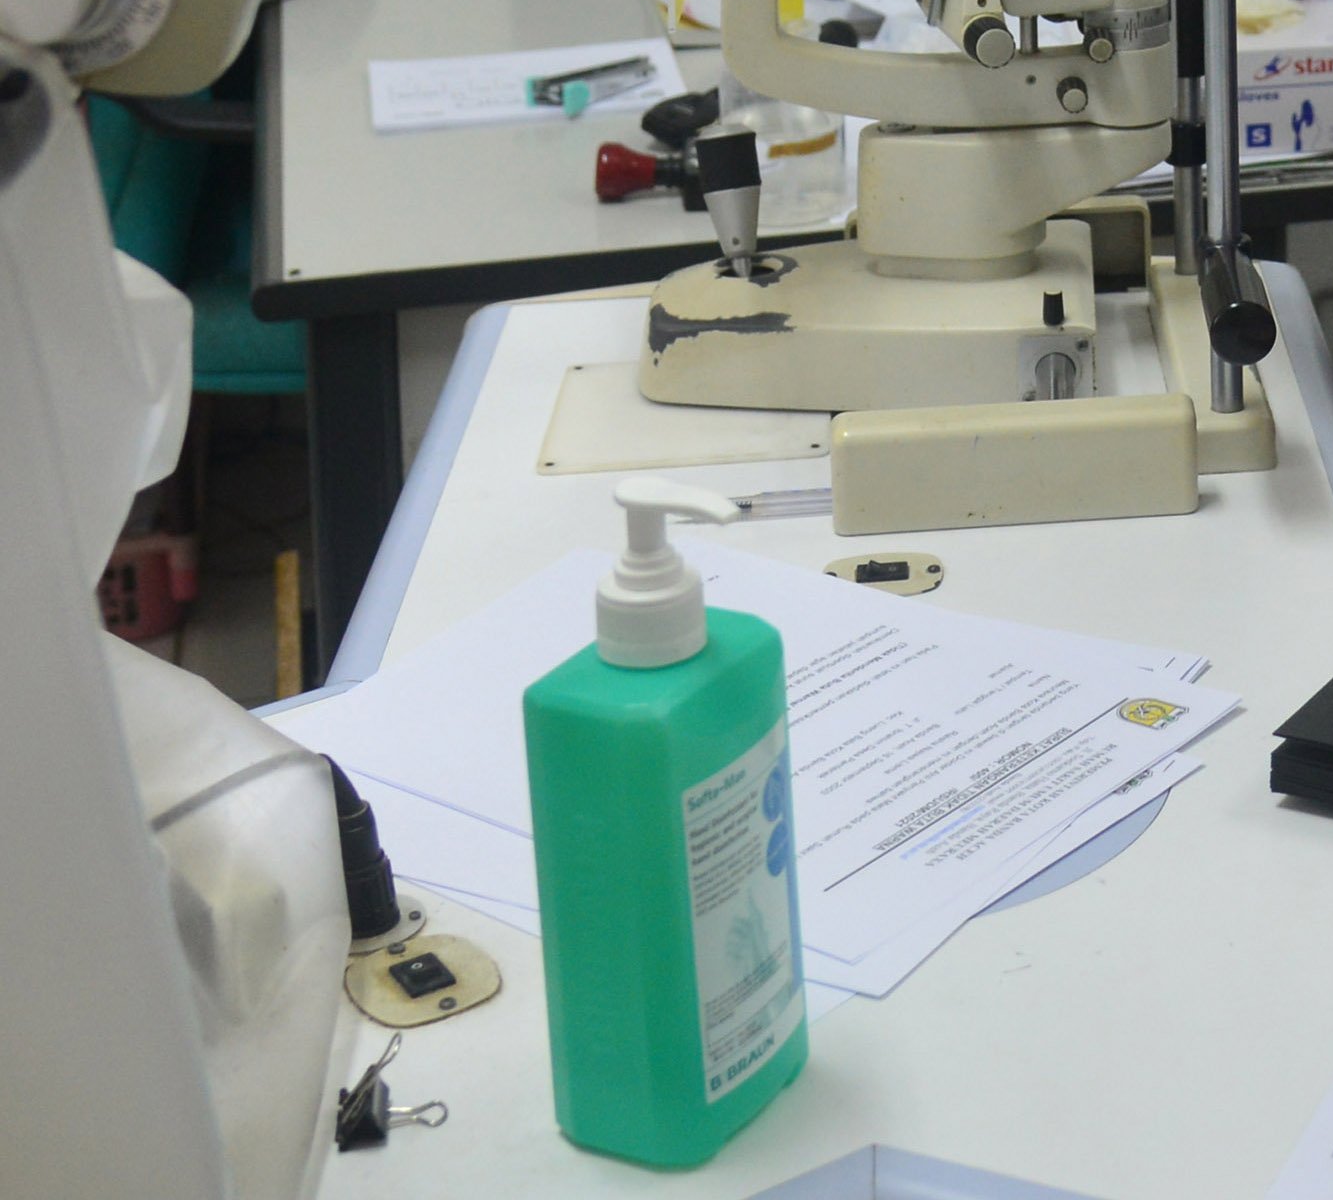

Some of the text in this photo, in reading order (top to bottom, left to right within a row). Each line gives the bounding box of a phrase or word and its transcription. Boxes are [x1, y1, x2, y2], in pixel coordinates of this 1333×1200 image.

[1251, 127, 1267, 143] S
[817, 678, 843, 690] Buta
[993, 741, 1033, 764] NOMOR
[873, 728, 1073, 851] SURAT KETERANGAN TIDAK BUTA WARNA
[923, 743, 1118, 867] RUMAH SAKIT UMUM DAERAH MEURAXA
[954, 757, 1113, 860] PEMERINTAH KOTA BANDA ACEH
[727, 1035, 775, 1081] BRAUN
